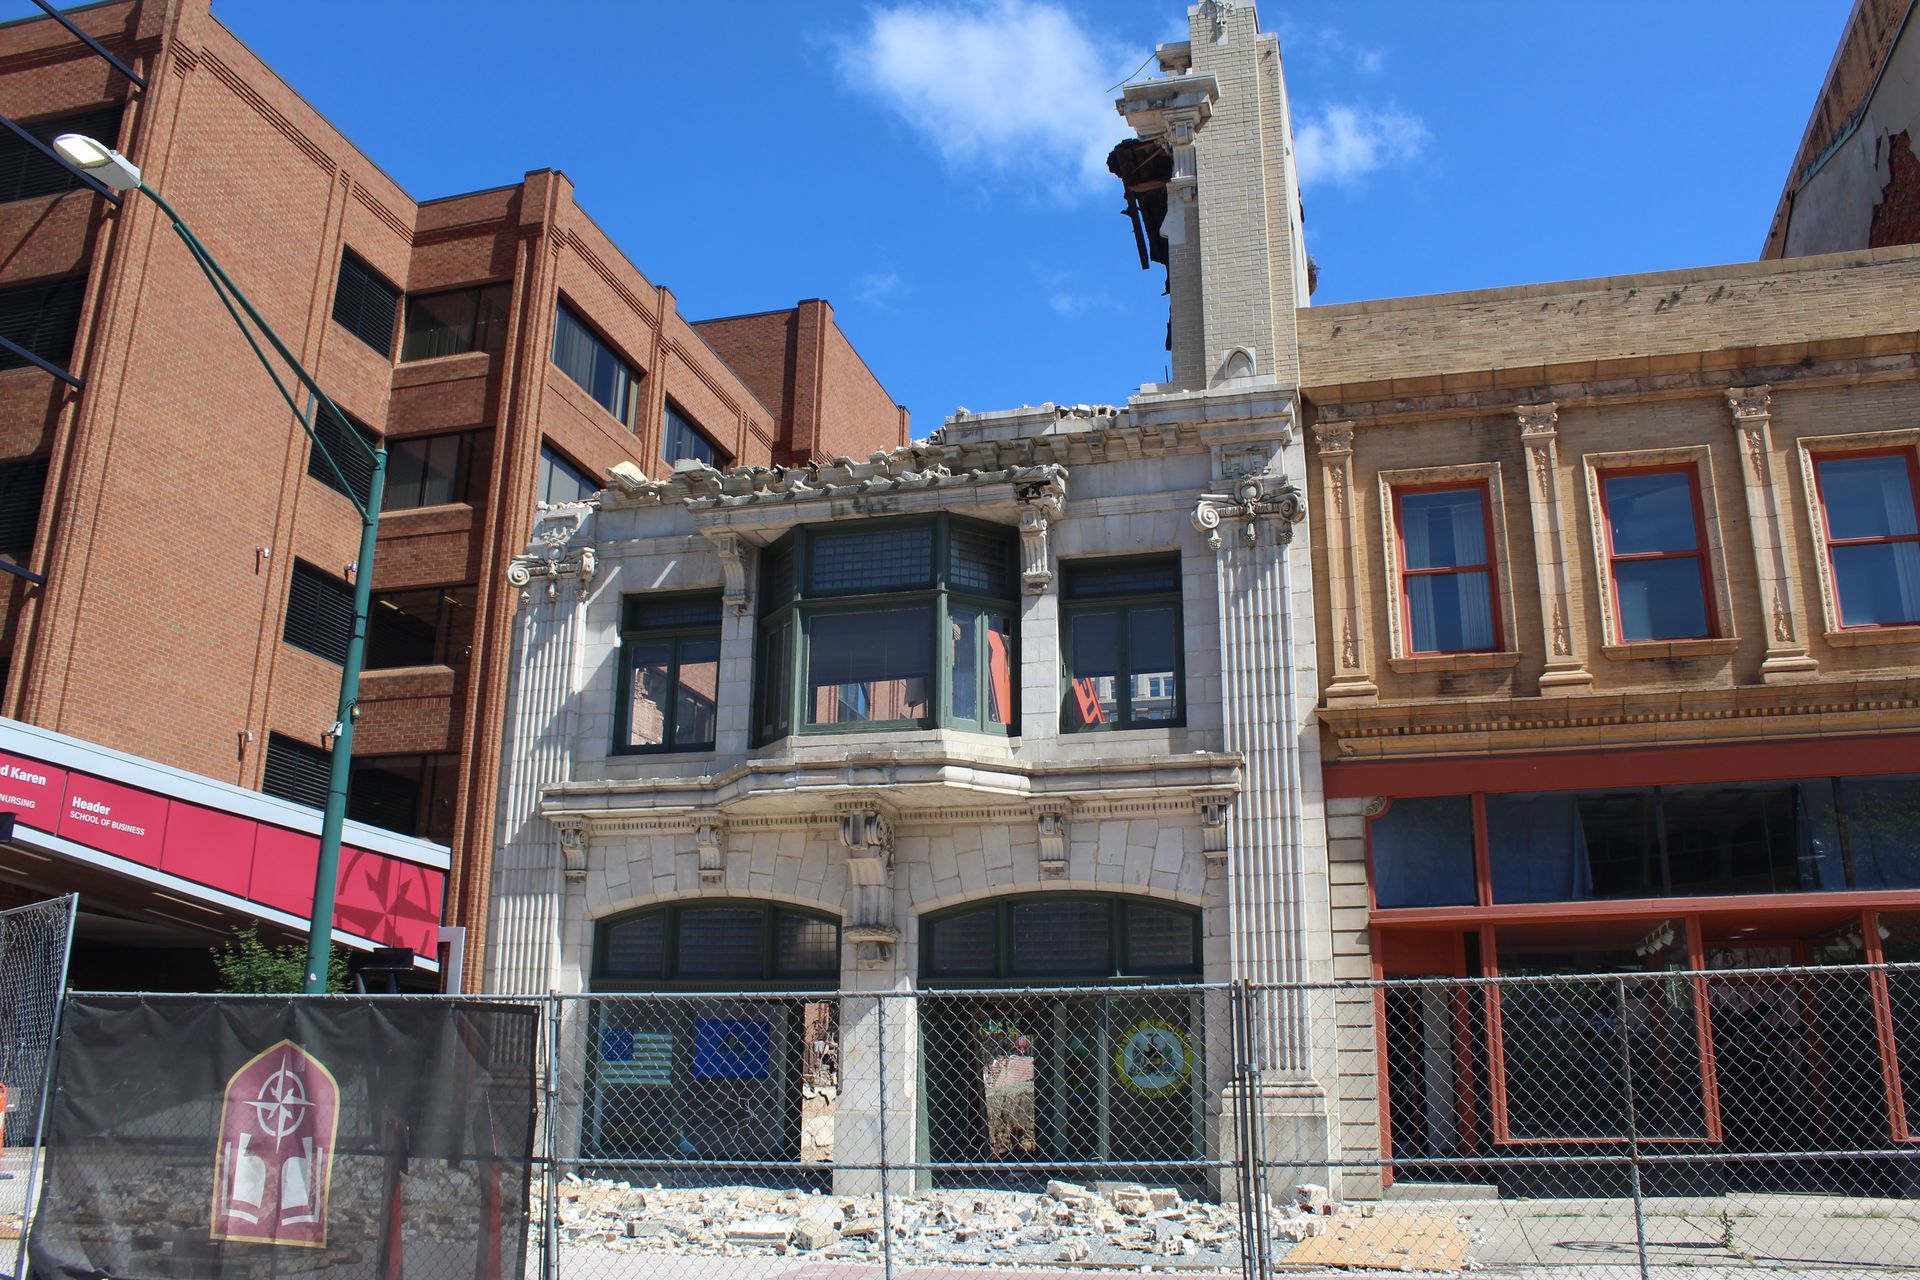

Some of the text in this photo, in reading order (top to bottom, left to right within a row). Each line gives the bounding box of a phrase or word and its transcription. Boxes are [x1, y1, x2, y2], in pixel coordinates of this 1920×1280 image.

[11, 766, 47, 785] Karen
[0, 793, 35, 808] NURSING
[72, 796, 111, 815] Header
[70, 811, 145, 836] SCHOOL OF BUSINESS
